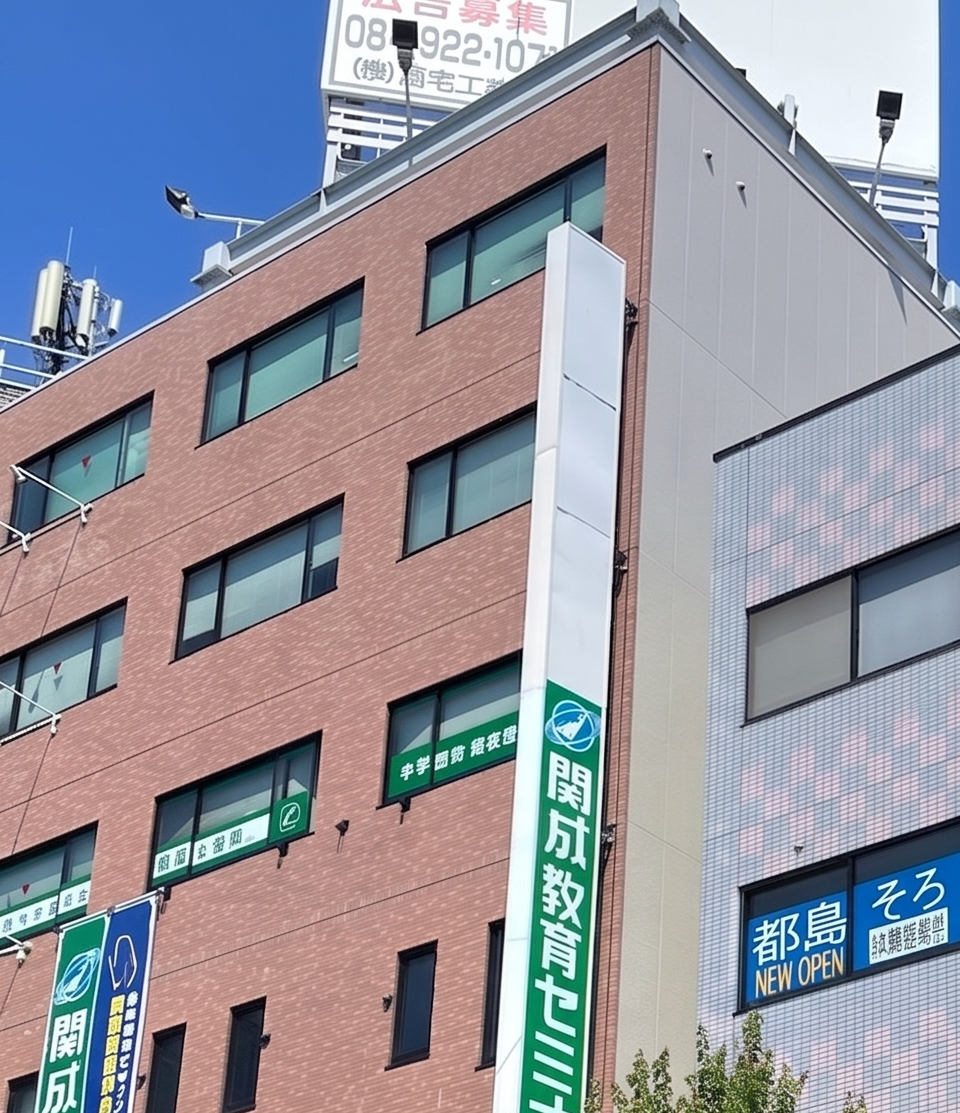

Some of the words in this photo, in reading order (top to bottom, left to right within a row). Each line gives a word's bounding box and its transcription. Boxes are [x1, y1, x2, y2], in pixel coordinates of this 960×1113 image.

[752, 901, 847, 966] 都島
[755, 962, 792, 999] NEW
[797, 947, 845, 987] OPEN
